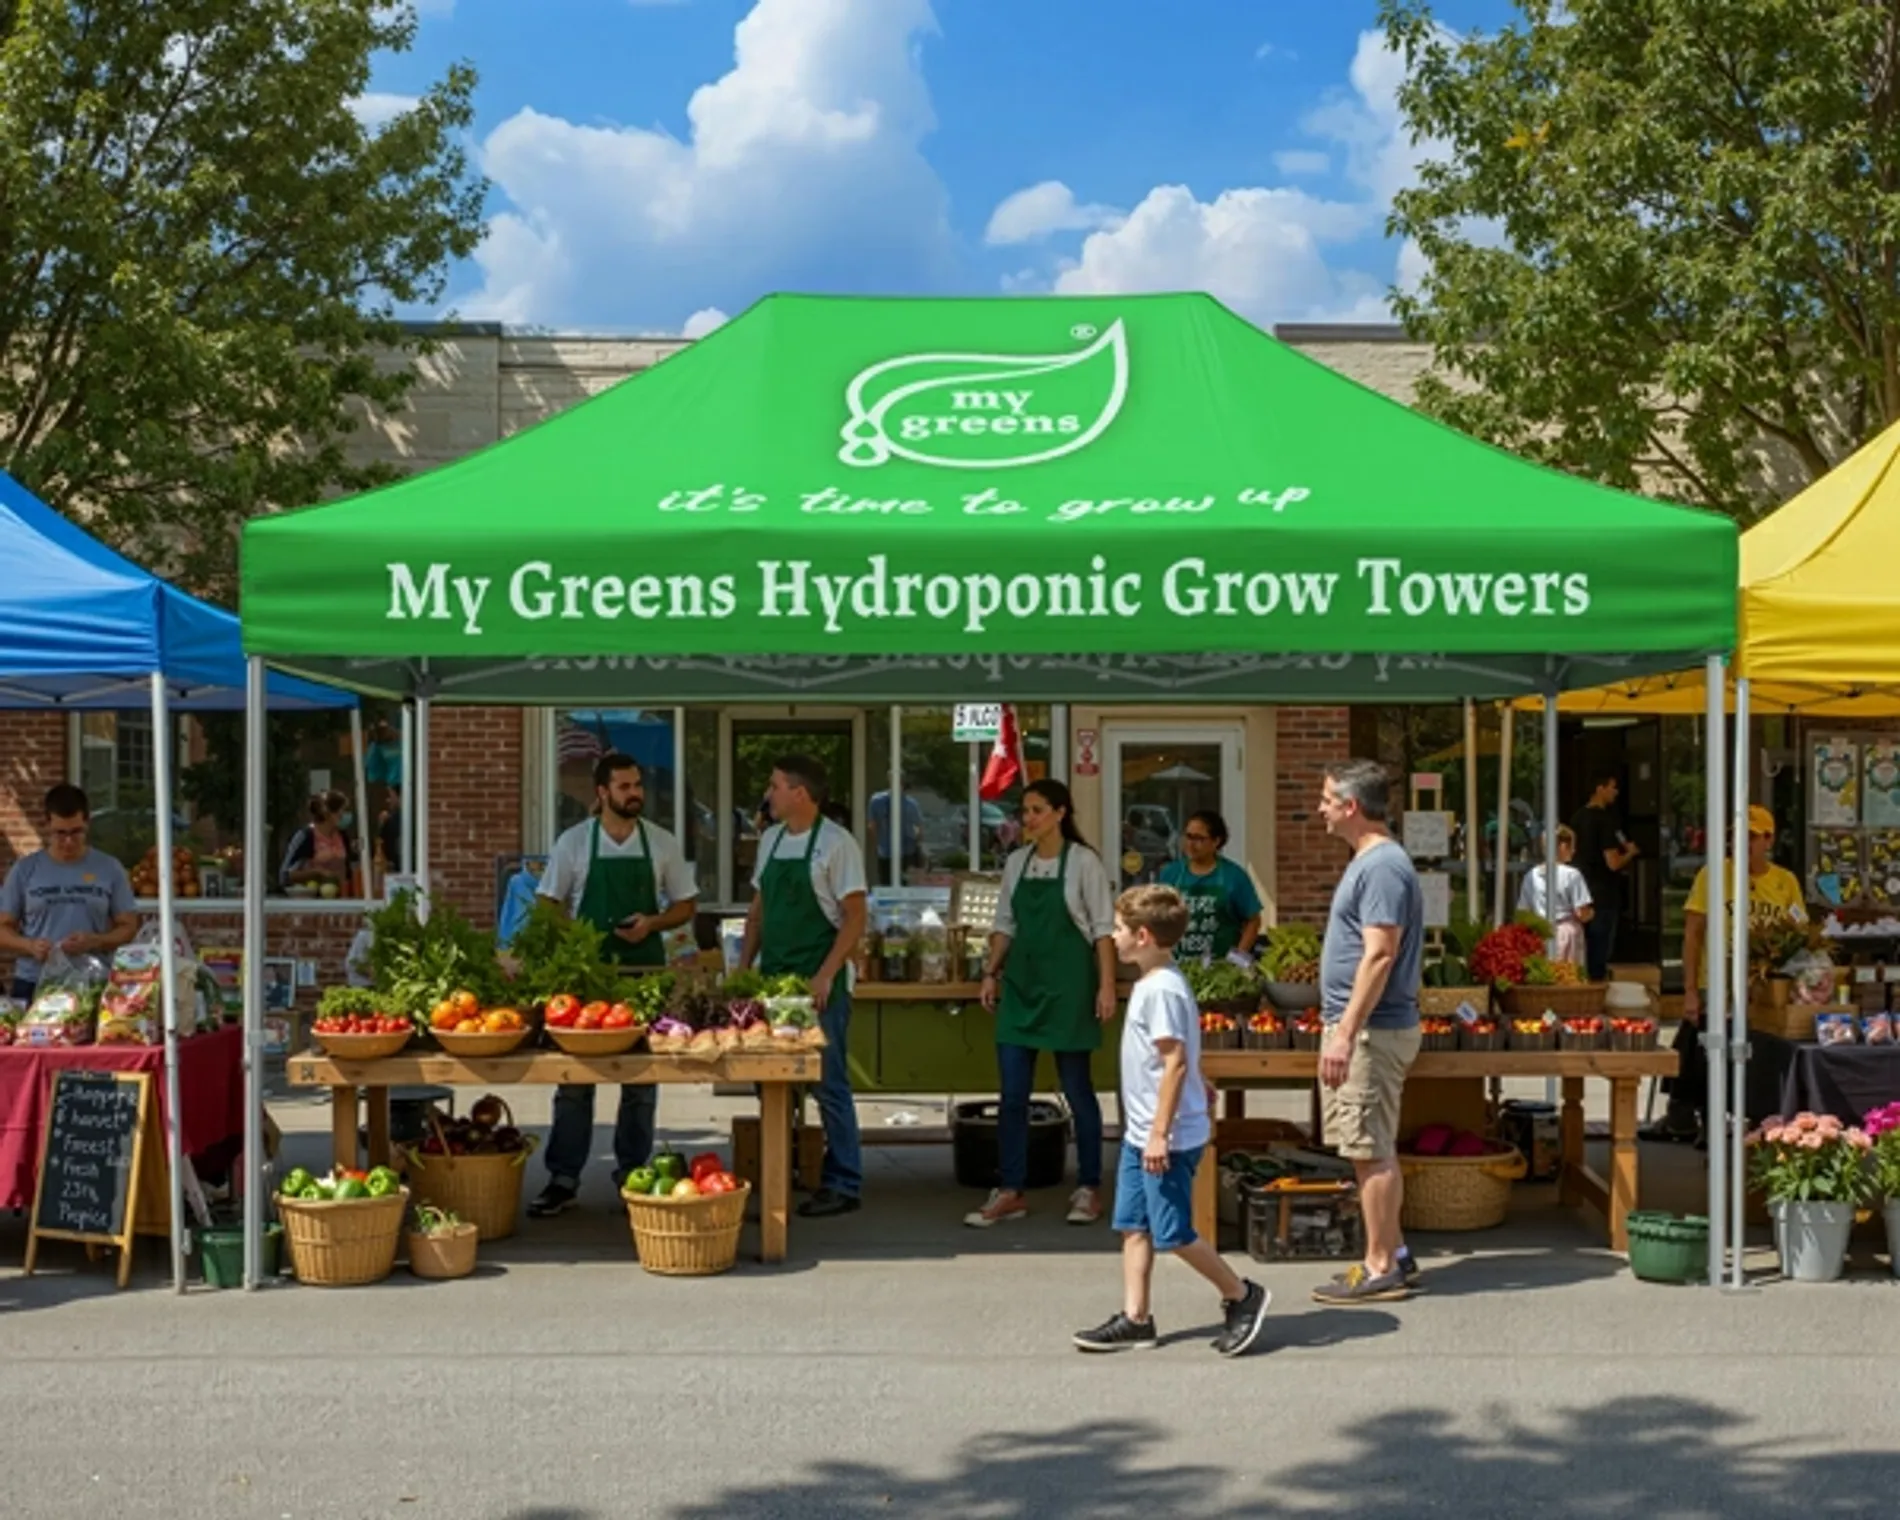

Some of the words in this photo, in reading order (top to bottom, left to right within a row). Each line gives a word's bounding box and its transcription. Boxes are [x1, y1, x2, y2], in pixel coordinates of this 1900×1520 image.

[950, 389, 1034, 414] my
[899, 411, 1081, 440] greens
[657, 484, 768, 513] it's
[800, 486, 933, 515] time
[962, 487, 1027, 515] to
[1046, 495, 1215, 522] grow
[1238, 485, 1312, 512] up
[386, 562, 490, 635] My
[509, 560, 737, 620] Greens
[757, 554, 1142, 633] Hydroponic
[1162, 556, 1339, 617] Grow
[1357, 557, 1590, 618] Towers
